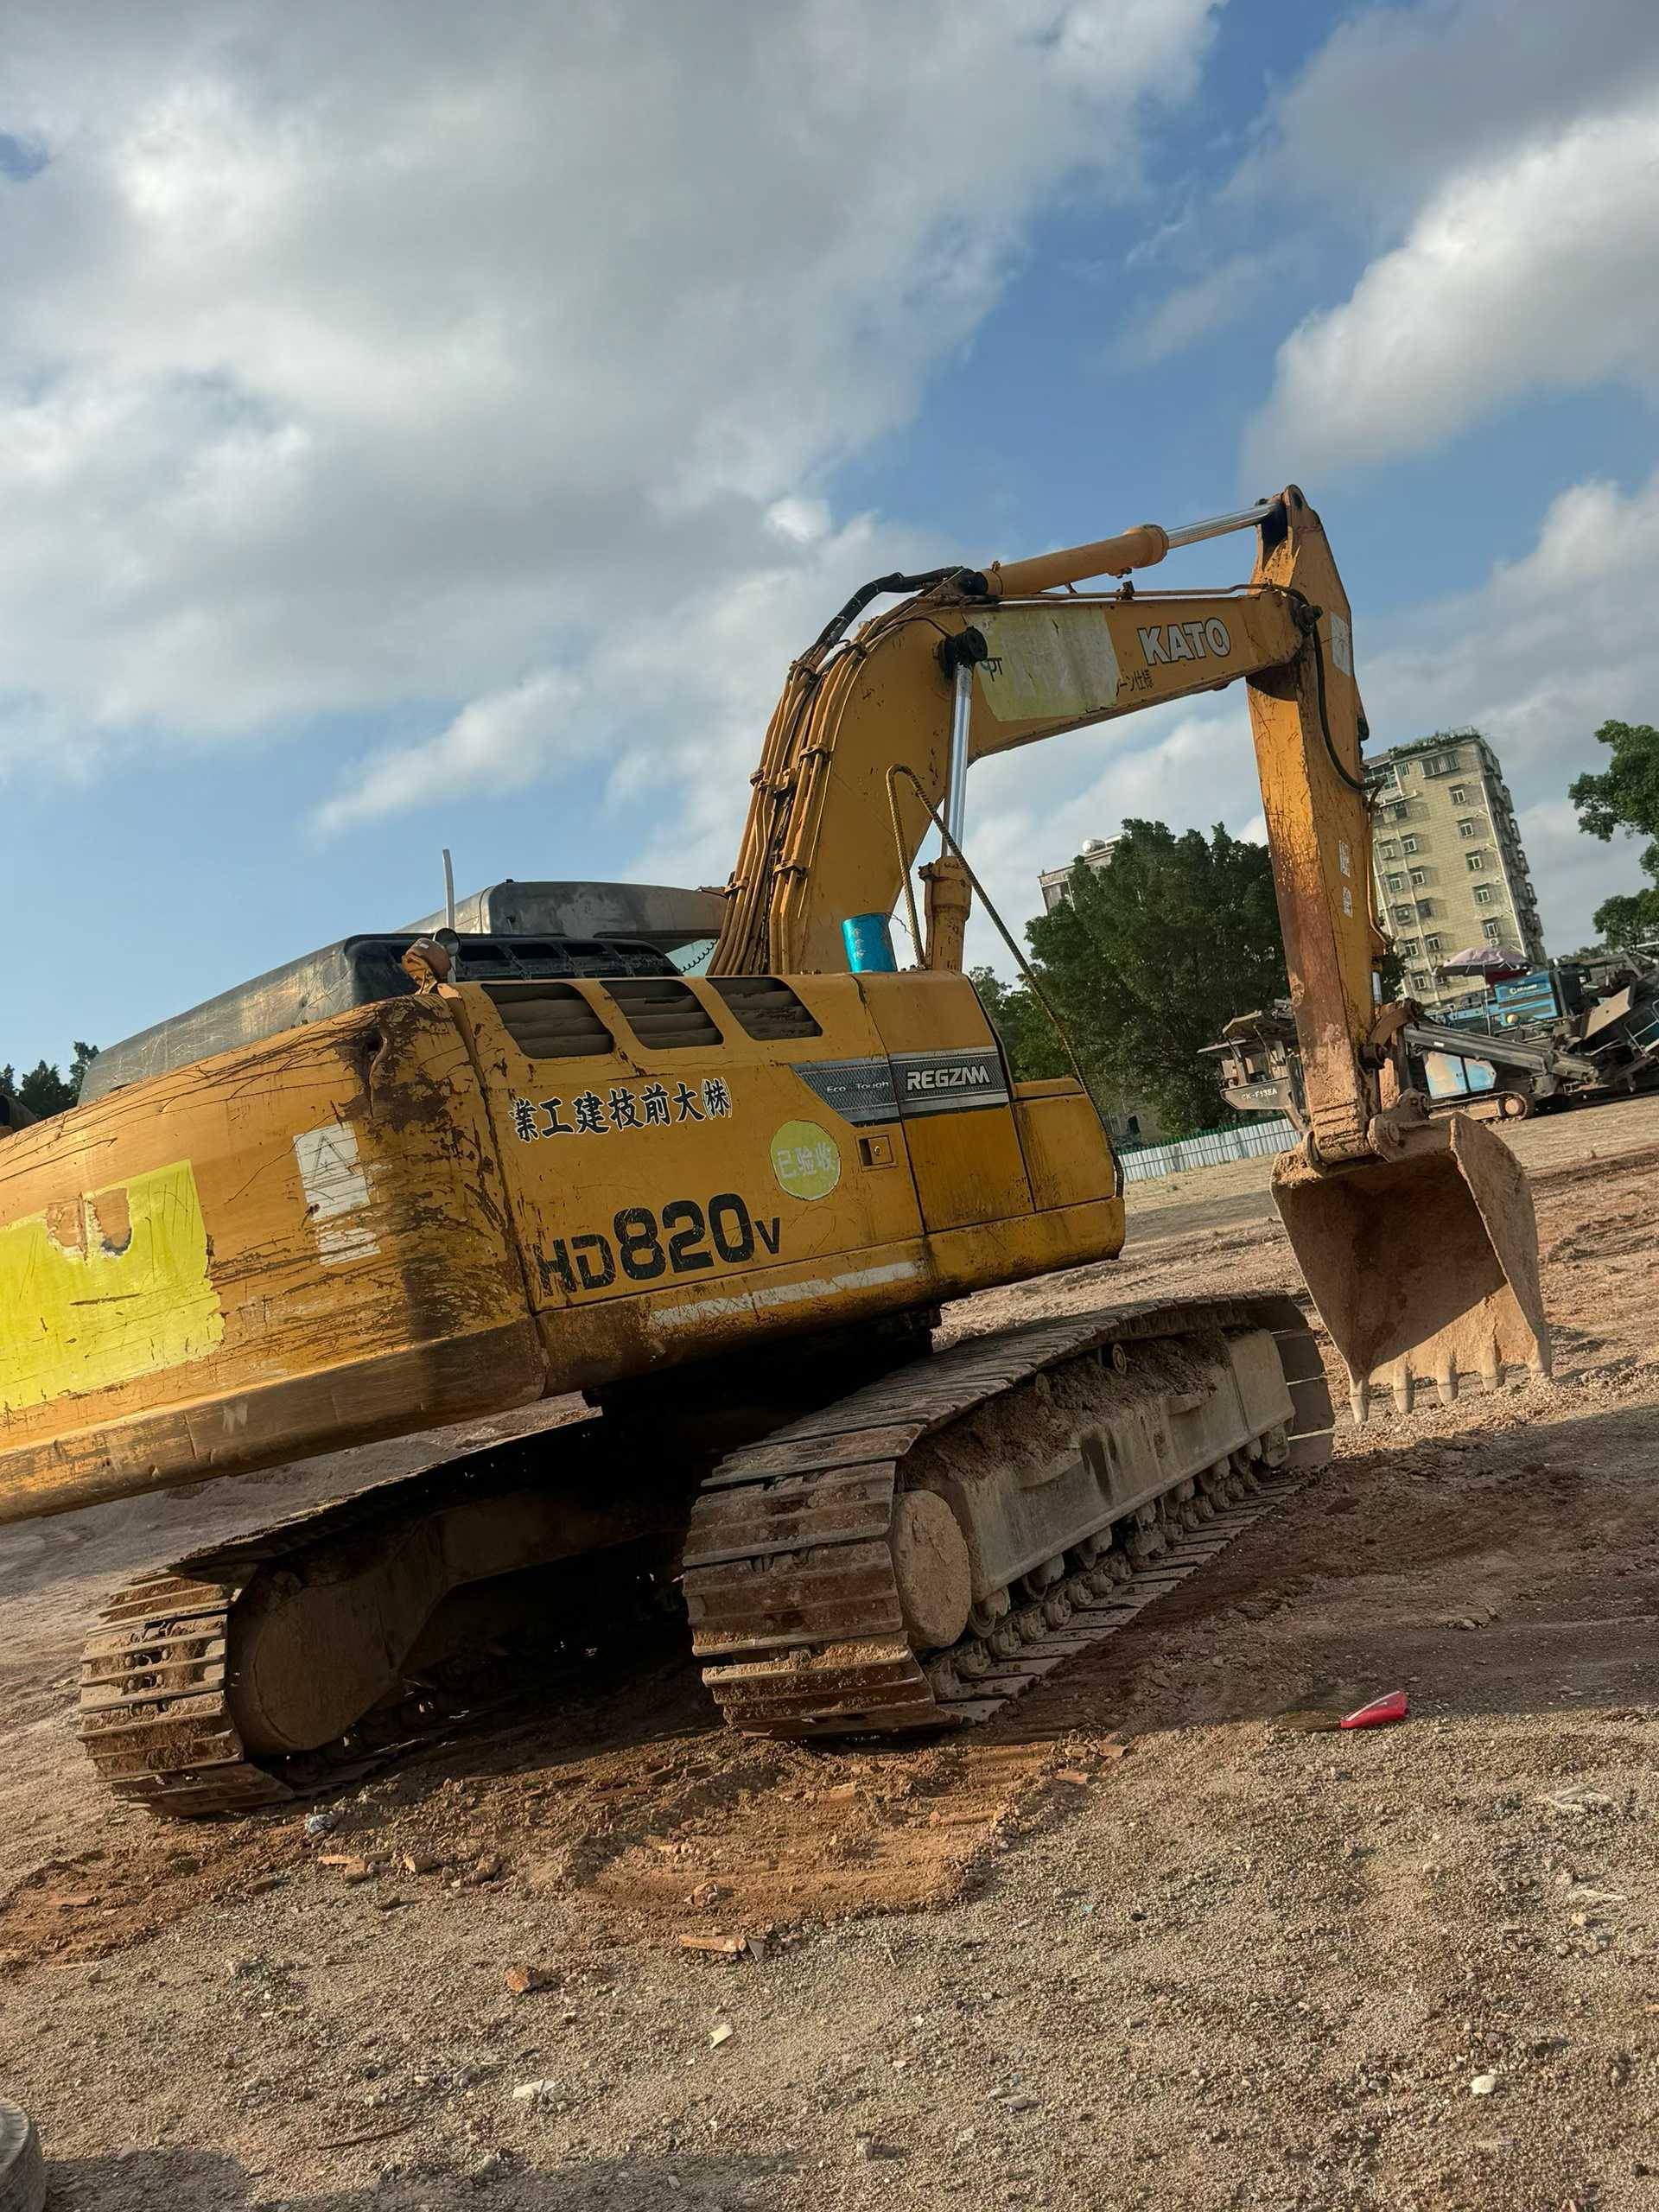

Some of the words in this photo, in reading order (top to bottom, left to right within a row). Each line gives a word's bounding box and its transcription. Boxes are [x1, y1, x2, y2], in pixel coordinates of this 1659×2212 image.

[1137, 617, 1231, 665] KATO
[856, 1080, 890, 1090] Tough
[777, 1141, 836, 1178] 已验收
